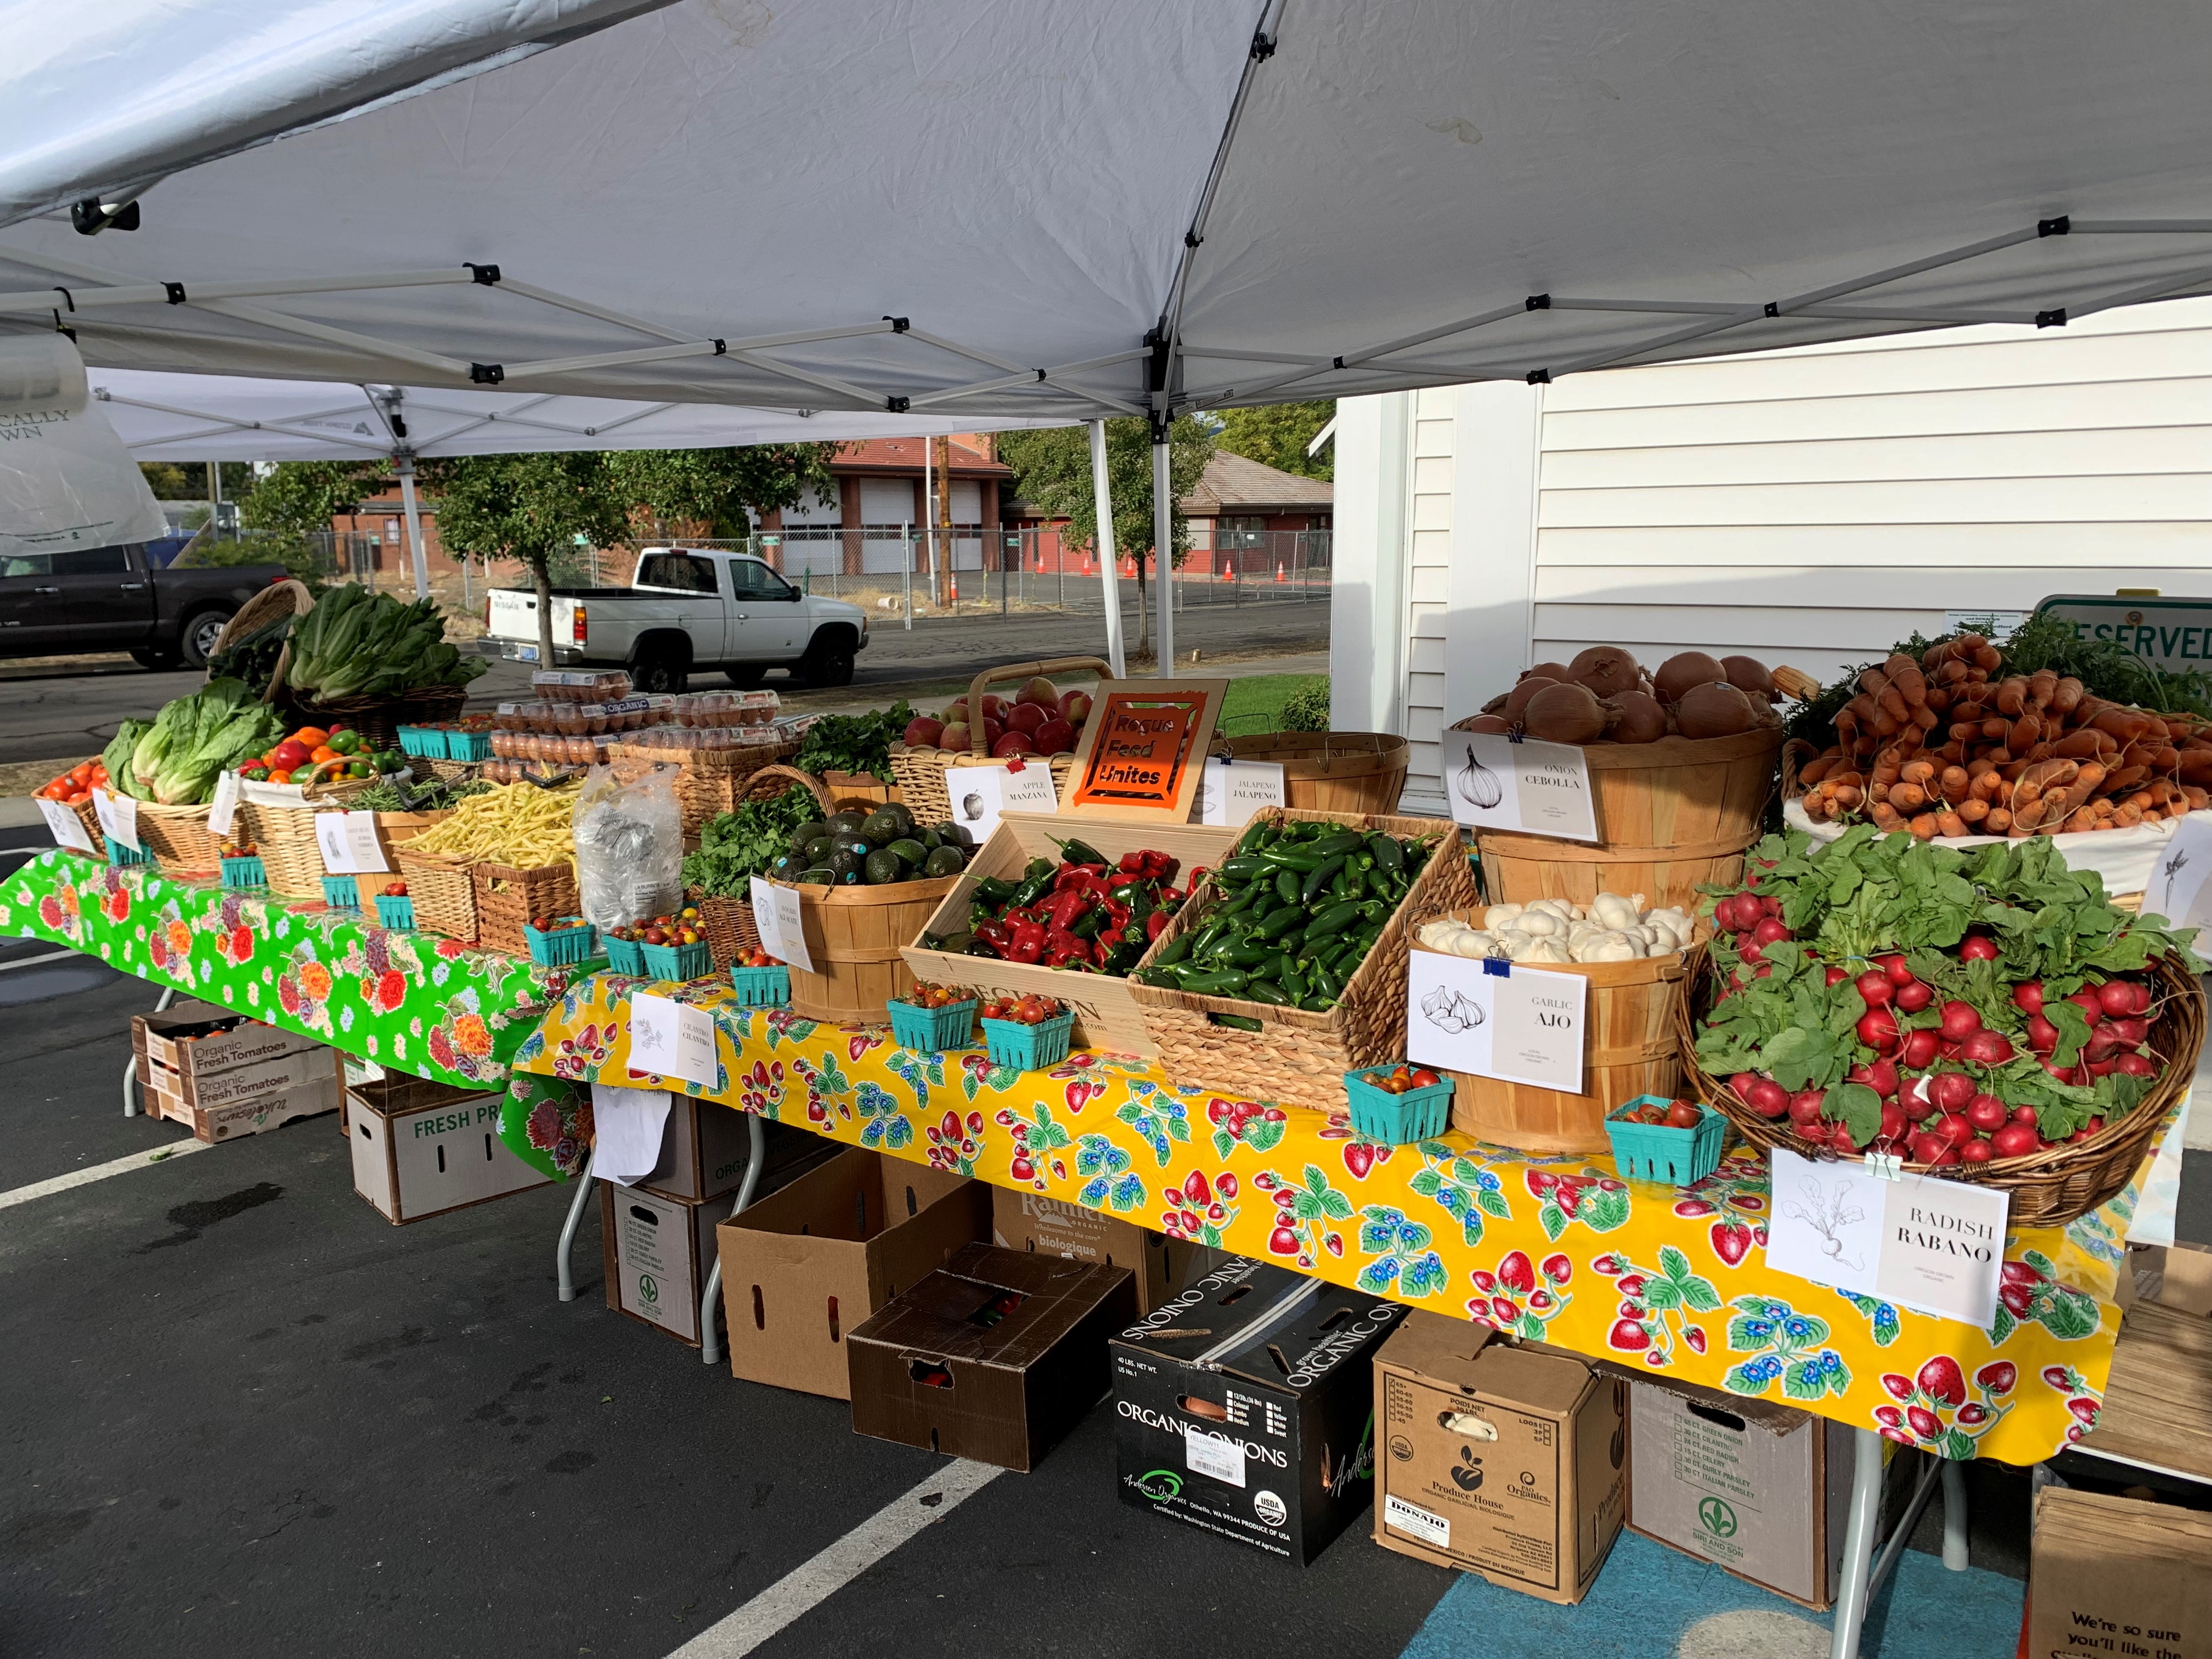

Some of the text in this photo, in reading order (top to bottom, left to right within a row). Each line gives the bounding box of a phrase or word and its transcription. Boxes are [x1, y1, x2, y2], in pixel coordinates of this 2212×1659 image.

[494, 601, 519, 610] NISSAN
[2074, 624, 2212, 659] ESERVED
[607, 699, 647, 712] ORGANIC
[1115, 715, 1174, 736] Rogue
[1099, 765, 1161, 785] Unites
[1545, 764, 1577, 776] ONION
[1239, 781, 1276, 789] JALAPENO
[1525, 775, 1580, 789] CEBOLLA
[1009, 792, 1047, 800] MANZANA
[1233, 790, 1276, 800] JALAPENO
[781, 905, 797, 915] AVOCADO
[779, 914, 798, 926] AGUACATE
[1532, 996, 1573, 1010] GARLIC
[1533, 1012, 1571, 1029] AJO
[684, 1022, 708, 1037] CILANTRO
[682, 1032, 709, 1047] CILANTRO
[194, 1040, 242, 1058] Organic
[196, 1042, 286, 1070] Fresh Tomatoes
[196, 1074, 245, 1093] Organic
[199, 1074, 290, 1104] Fresh Tomatoes
[414, 1103, 503, 1139] FRESH PR
[1034, 1223, 1067, 1235] Wholesome
[1071, 1221, 1107, 1232] ORGANIC
[1909, 1207, 1996, 1241] RADISH
[1039, 1234, 1097, 1256] biologique
[1897, 1226, 1992, 1263] RABANO
[1914, 1266, 1955, 1280] OREGON GROWN
[1922, 1274, 1945, 1283] ORGANIC
[1121, 1255, 1249, 1340] ANIC ONIONS
[1287, 1322, 1378, 1387] ORGANIC
[1296, 1330, 1344, 1367] grown healthier
[1125, 1358, 1136, 1367] LBS.
[1137, 1362, 1147, 1370] NET
[1148, 1365, 1157, 1374] WT.
[1396, 1389, 1413, 1398] 60-65
[1396, 1396, 1413, 1406] 55-60
[1273, 1404, 1282, 1413] Red
[1450, 1398, 1486, 1413] POIDS NET
[1233, 1409, 1248, 1419] Jumbo
[1273, 1412, 1288, 1422] Yellow
[1396, 1410, 1413, 1420] 45-50
[1273, 1420, 1286, 1430] White
[1519, 1418, 1543, 1429] LOOSE
[1274, 1428, 1287, 1438] Sweet
[1692, 1421, 1701, 1430] CT.
[1702, 1425, 1722, 1438] GREEN
[1723, 1434, 1743, 1446] ONION
[1190, 1435, 1220, 1449] YELLOW11
[1395, 1441, 1408, 1450] USDA
[1692, 1431, 1701, 1440] CT.
[1702, 1435, 1733, 1452] CILANTRO
[1692, 1441, 1701, 1449] CT.
[1702, 1445, 1714, 1454] RED
[1716, 1450, 1739, 1464] RADISH
[1692, 1450, 1701, 1459] CT.
[1702, 1454, 1725, 1468] CELERY
[1692, 1460, 1701, 1468] CT.
[1702, 1464, 1722, 1476] CURLY
[1723, 1472, 1750, 1488] PARSLEY
[1123, 1474, 1187, 1505] Andersen Organics
[1521, 1485, 1534, 1493] PAO
[1692, 1469, 1701, 1478] CT.
[1702, 1473, 1726, 1488] ITALIAN
[1727, 1483, 1755, 1499] PARSLEY
[1432, 1480, 1471, 1500] Produce
[1474, 1494, 1504, 1510] House
[1506, 1483, 1549, 1504] Organics
[1261, 1497, 1280, 1510] USDA
[1421, 1487, 1446, 1500] ORGANIC
[1479, 1506, 1515, 1521] BIOLOGIQUE
[1258, 1506, 1283, 1520] ORGANIC
[1153, 1503, 1290, 1557] Certified by: Washington State Department of Agriculture
[1189, 1502, 1291, 1542] Othello, WA 99344 PRODUCE OF USA
[1692, 1532, 1707, 1543] SIRI
[1709, 1539, 1725, 1550] AND
[1727, 1547, 1743, 1558] SON
[1414, 1535, 1437, 1550] PRODUCT
[1446, 1547, 1465, 1558] MEXICO
[1469, 1553, 1491, 1567] PRODUIT
[1501, 1564, 1525, 1576] MEXIQUE
[2072, 1611, 2182, 1642] We're so sure
[2067, 1633, 2182, 1659] you'll like the
